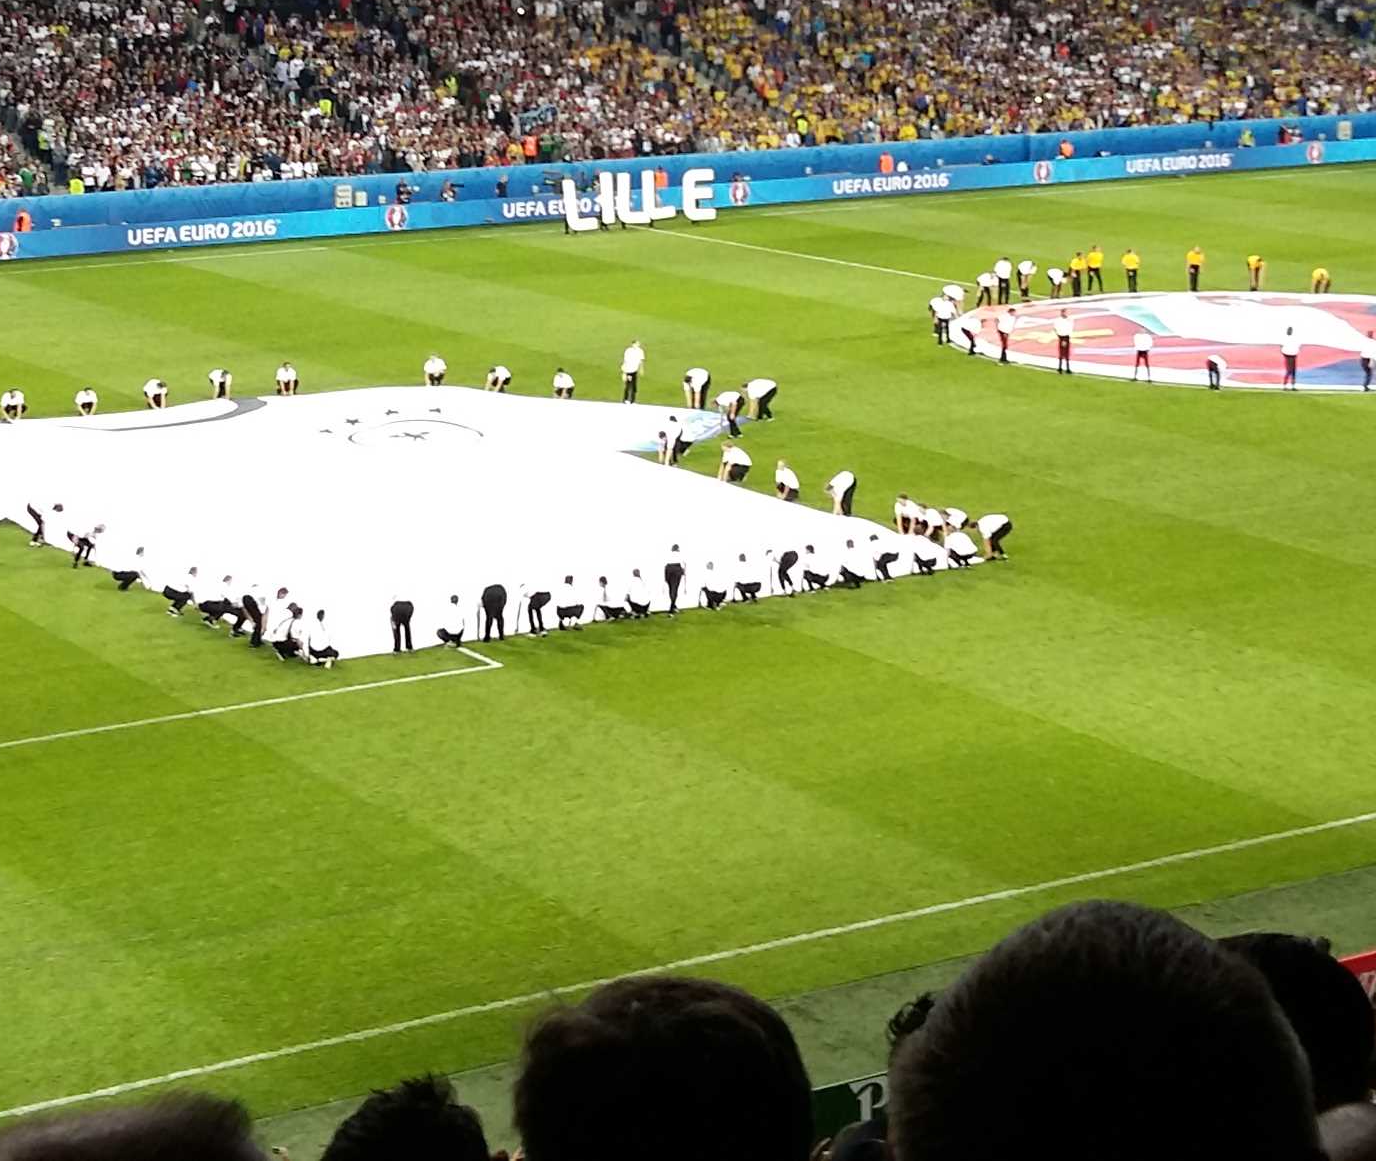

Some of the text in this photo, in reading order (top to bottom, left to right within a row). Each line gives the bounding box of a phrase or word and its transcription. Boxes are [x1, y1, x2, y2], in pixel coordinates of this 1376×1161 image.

[1126, 154, 1232, 174] UEFA EURO 2016
[833, 173, 950, 195] UEFA EURO 2016
[502, 201, 547, 218] UEFA
[562, 168, 717, 231] LILLE
[128, 220, 277, 245] UEFA EURO 2016
